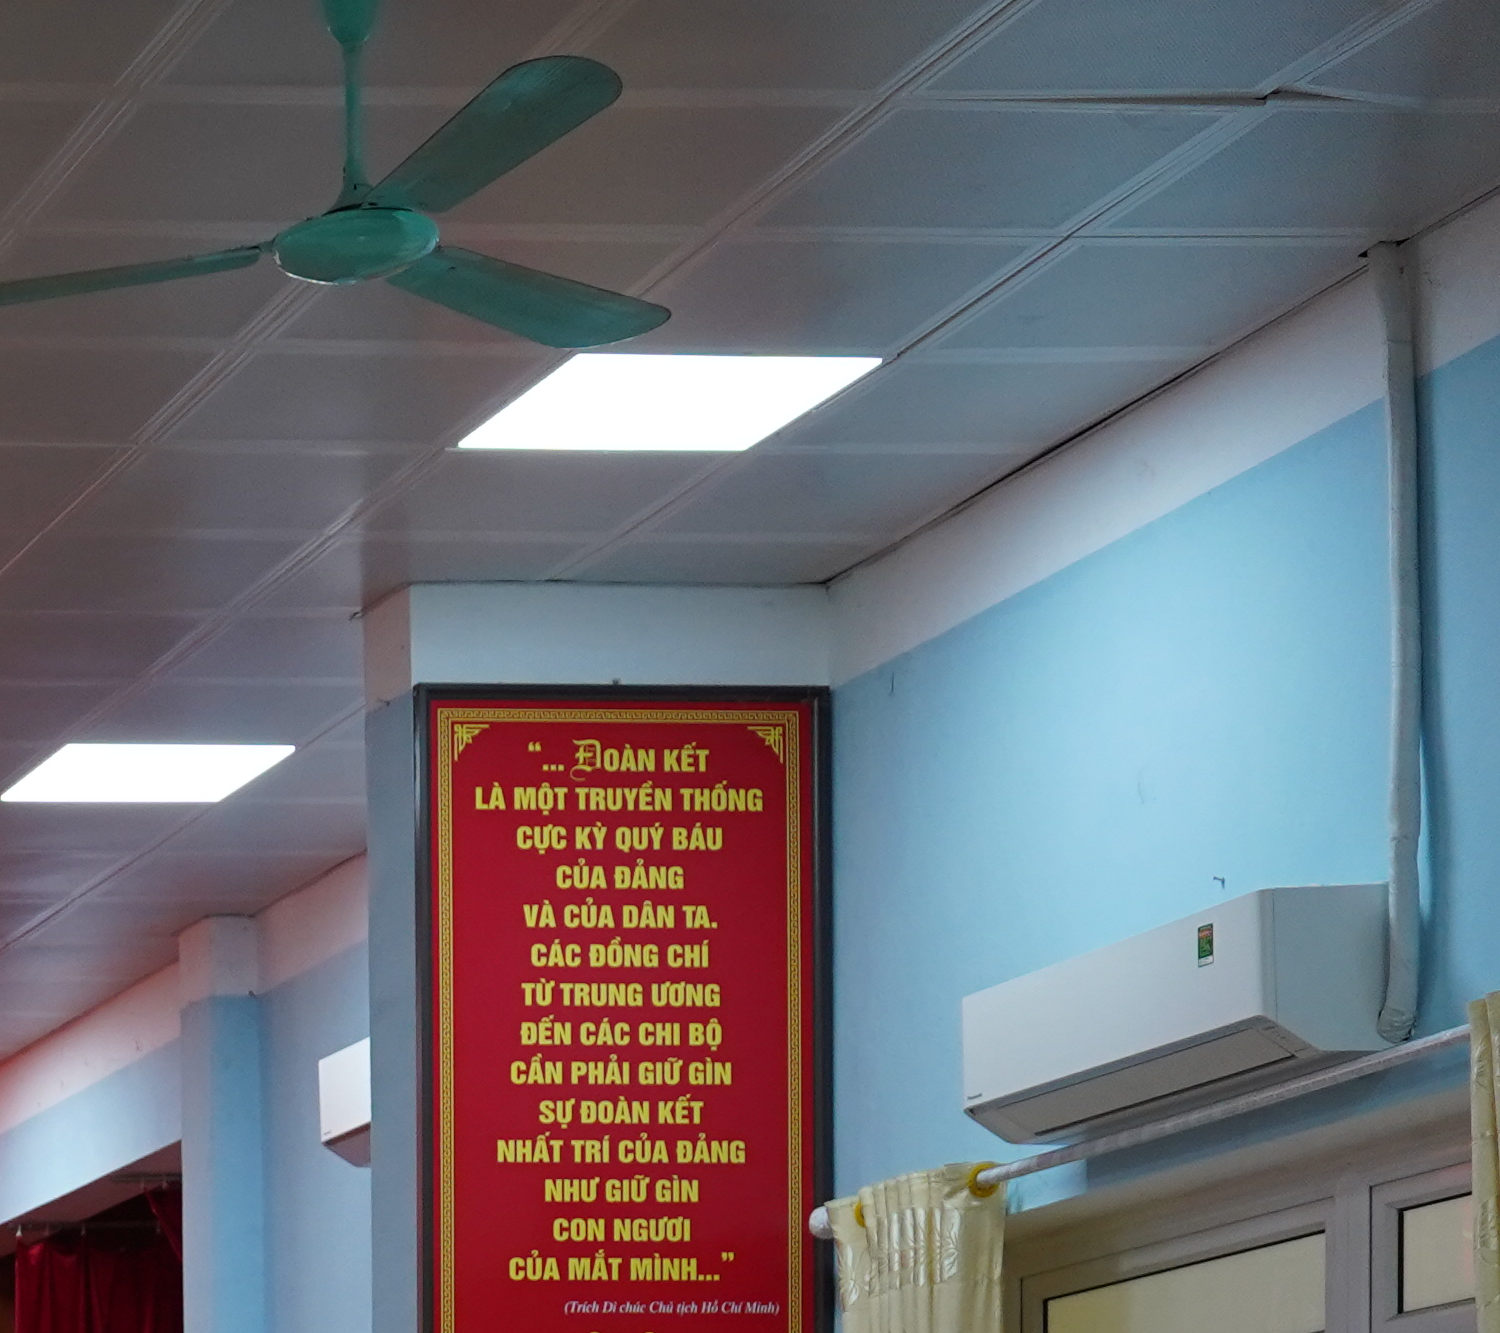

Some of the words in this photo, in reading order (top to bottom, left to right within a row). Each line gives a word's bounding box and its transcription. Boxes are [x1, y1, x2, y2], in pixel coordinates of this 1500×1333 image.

[572, 739, 655, 780] ĐOÀN
[664, 742, 709, 772] KẾT
[475, 782, 506, 810] LÀ
[514, 782, 568, 815] MỘT
[575, 781, 672, 811] TRUYỀN
[680, 781, 763, 811] THỐNG
[517, 824, 567, 854] CỰC
[575, 822, 607, 849] KỲ
[615, 822, 664, 852] QUÝ
[672, 823, 722, 850] BÁU
[556, 858, 607, 889] CỦA
[614, 859, 684, 889] ĐẢNG
[523, 900, 556, 928] VÀ
[564, 897, 615, 928] CỦA
[623, 901, 674, 928] DÂN
[682, 905, 717, 928] TA.
[531, 939, 581, 967] CÁC
[589, 936, 659, 968] ĐỒNG
[667, 940, 708, 968] CHÍ
[521, 978, 555, 1006] TỪ
[559, 983, 643, 1007] TRUNG
[651, 981, 720, 1007] ƯƠNG
[520, 1015, 571, 1045] ĐẾN
[580, 1018, 630, 1046] CÁC
[639, 1022, 680, 1046] CHI
[689, 1018, 722, 1051] BỘ
[511, 1054, 563, 1085] CẦN
[571, 1054, 630, 1085] PHẢI
[638, 1058, 683, 1085] GIỮ
[689, 1057, 731, 1085] GÌN
[539, 1098, 575, 1129] SỰ
[580, 1096, 649, 1124] ĐOÀN
[658, 1094, 704, 1124] KẾT
[497, 1132, 564, 1163] NHẤT
[571, 1135, 609, 1163] TRÍ
[618, 1133, 669, 1163] CỦA
[676, 1133, 745, 1163] ĐẢNG
[545, 1177, 600, 1202] NHƯ
[605, 1175, 650, 1202] GIỮ
[655, 1175, 698, 1202] GÌN
[553, 1218, 605, 1241] CON
[614, 1216, 690, 1242] NGƯƠI
[509, 1250, 560, 1281] CỦA
[568, 1249, 622, 1280] MẮT
